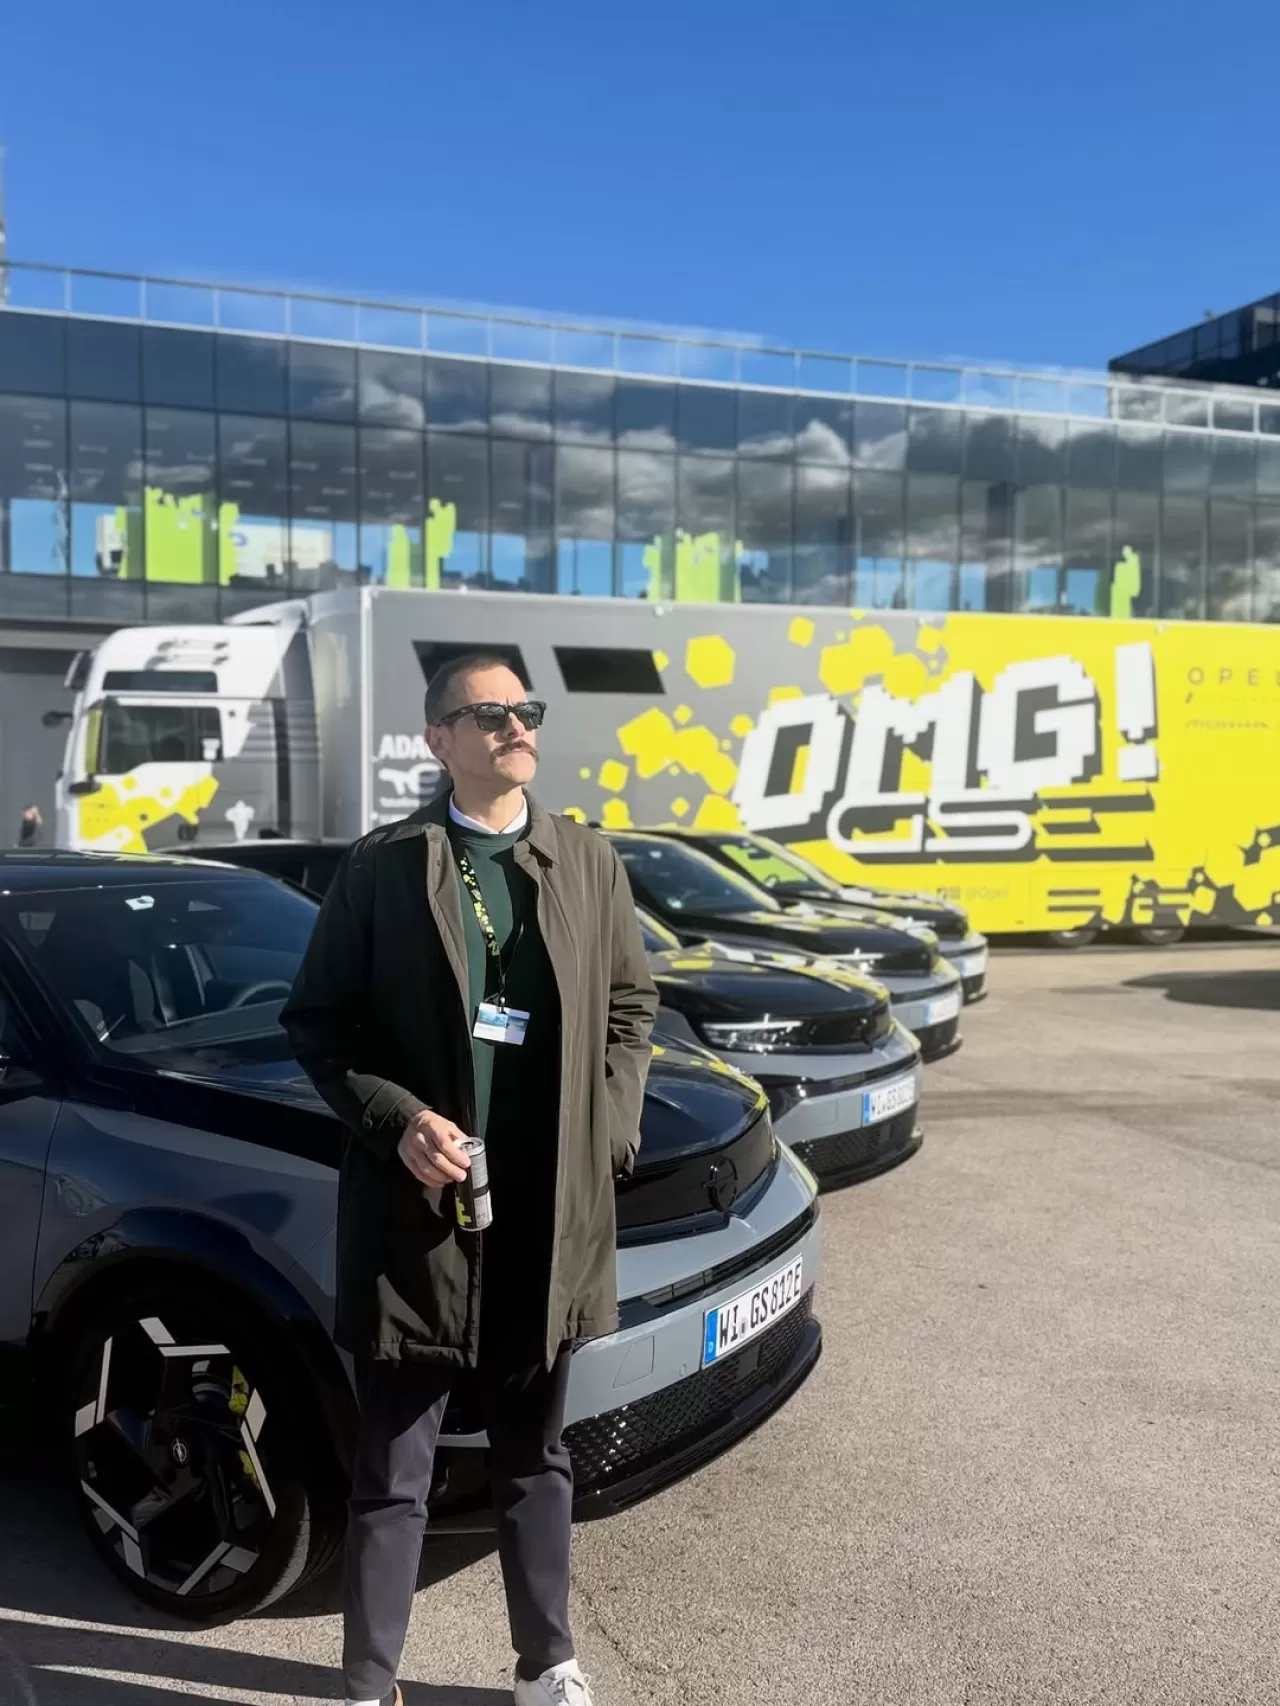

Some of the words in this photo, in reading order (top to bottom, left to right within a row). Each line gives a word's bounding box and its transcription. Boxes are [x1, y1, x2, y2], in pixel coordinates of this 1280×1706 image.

[379, 734, 436, 759] ADA
[732, 642, 1159, 831] OMG!
[827, 785, 1155, 864] GSE
[720, 1305, 738, 1348] WI
